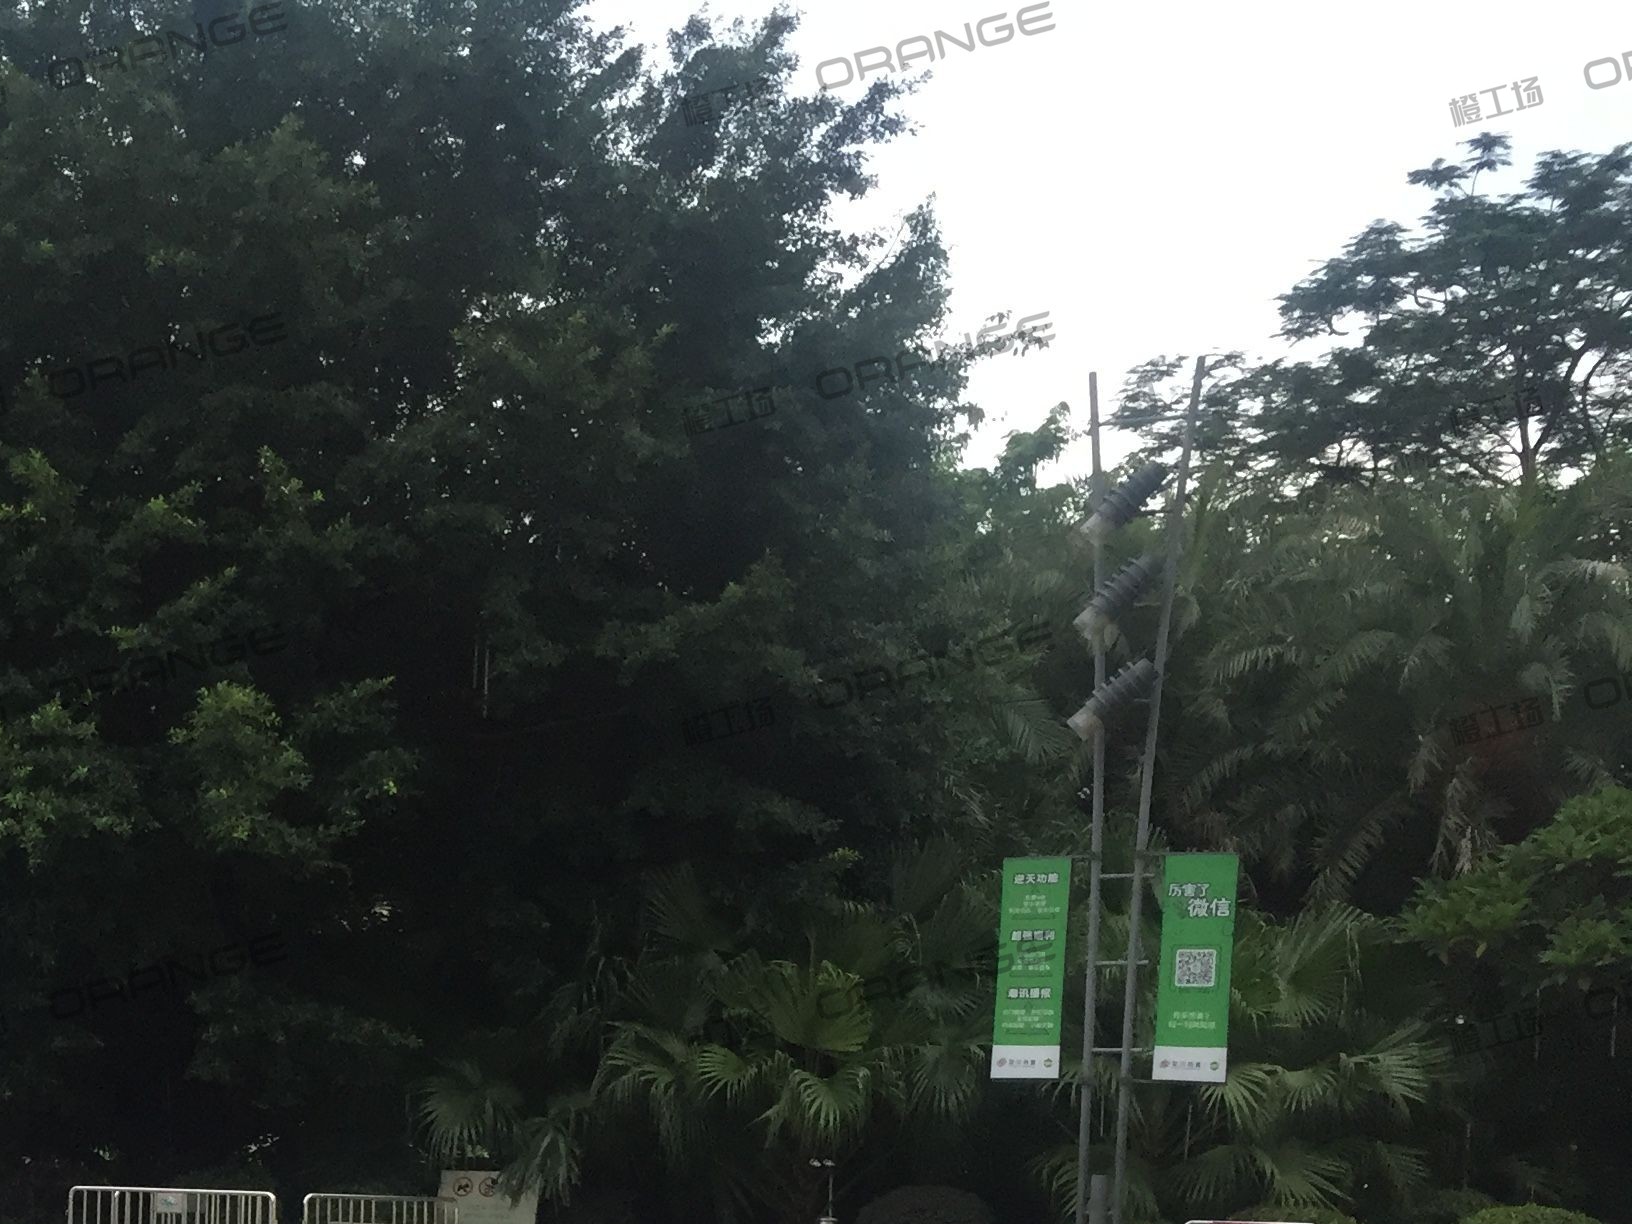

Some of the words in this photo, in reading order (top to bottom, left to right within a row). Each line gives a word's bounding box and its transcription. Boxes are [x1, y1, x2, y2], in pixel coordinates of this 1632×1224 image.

[1168, 882, 1210, 897] 厉害了
[1187, 897, 1231, 917] 微信
